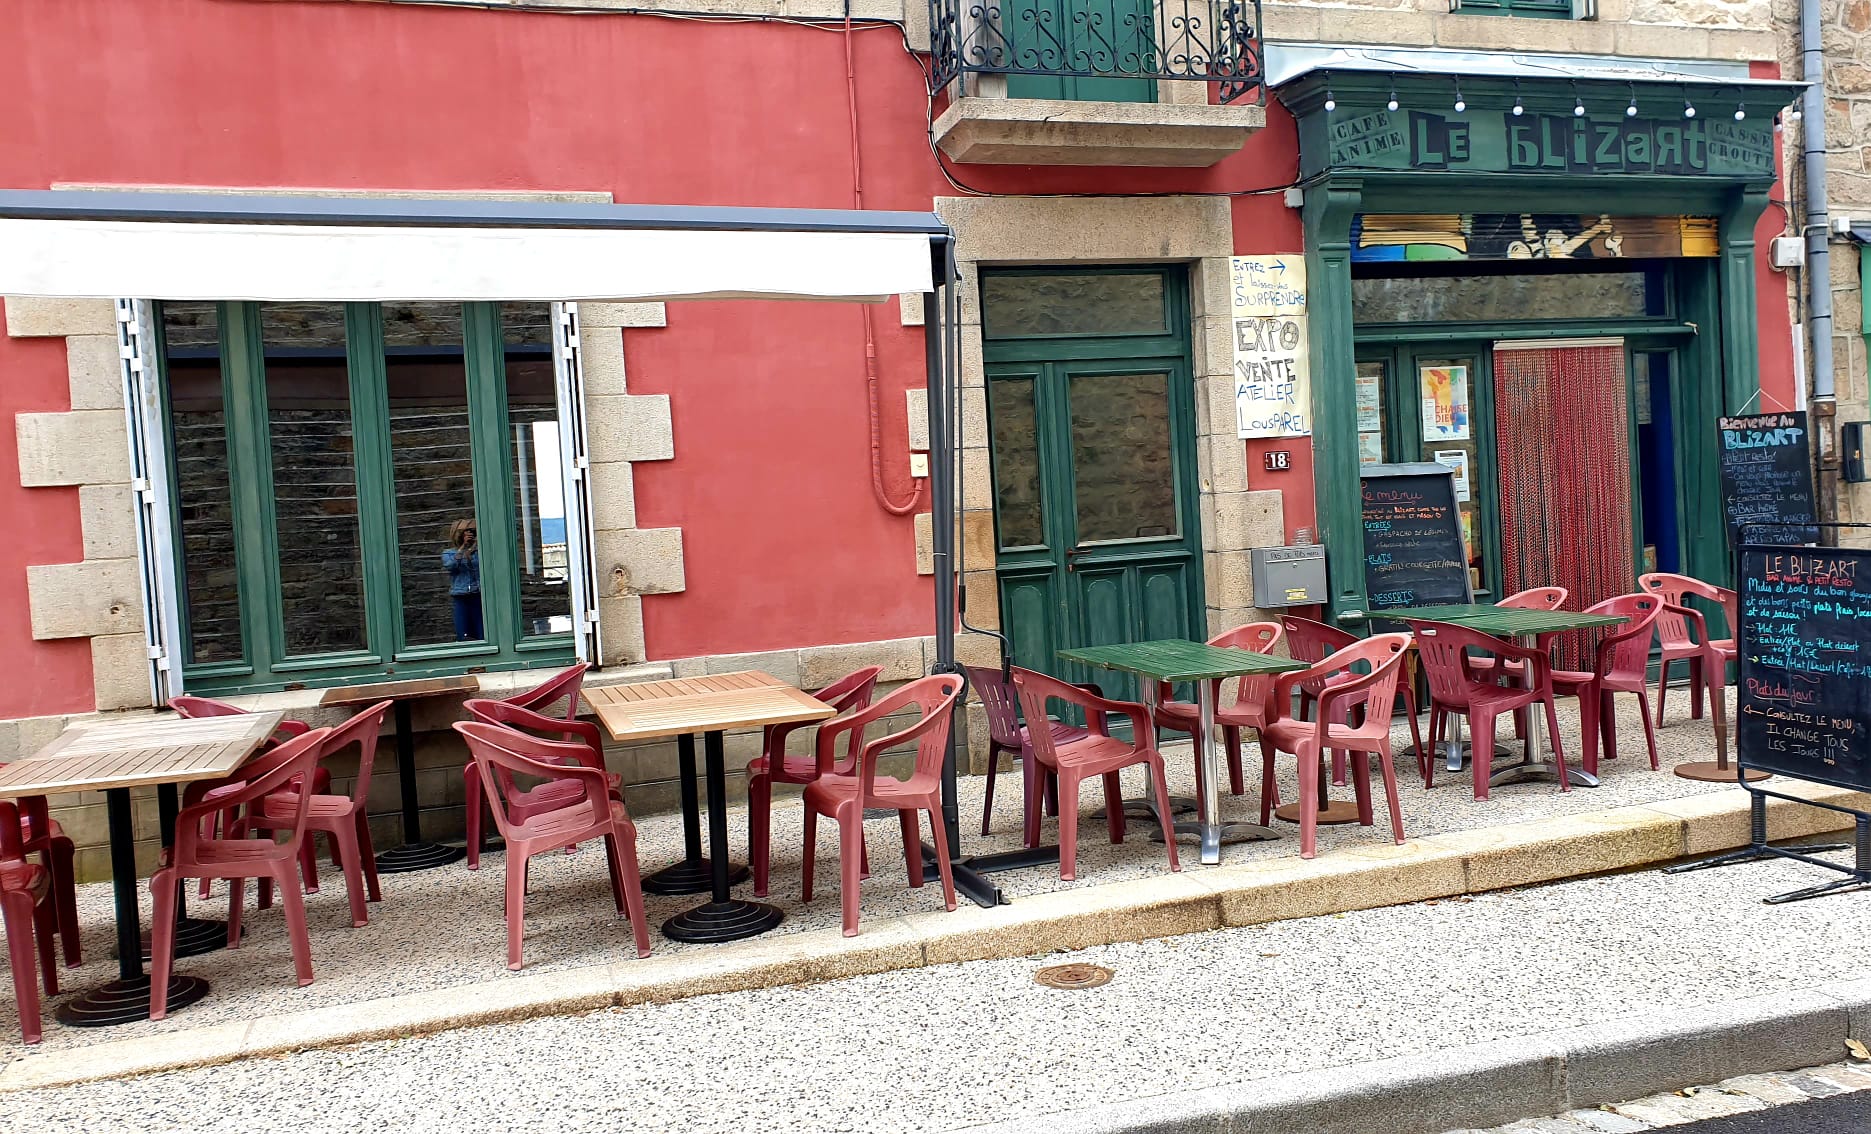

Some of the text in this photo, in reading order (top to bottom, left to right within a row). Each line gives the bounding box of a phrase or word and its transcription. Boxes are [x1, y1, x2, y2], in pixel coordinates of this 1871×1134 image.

[1715, 123, 1770, 148] CASSE
[1233, 272, 1244, 285] et
[1235, 319, 1299, 352] EXPO
[1235, 358, 1296, 383] VENTE
[1435, 404, 1468, 414] CHAISE
[1269, 453, 1287, 468] 18
[1377, 490, 1423, 500] menu
[1765, 555, 1783, 574] LE
[1775, 582, 1785, 593] et
[1816, 715, 1828, 726] LE
[1766, 722, 1781, 735] IL
[1783, 727, 1820, 743] CHANGE
[1768, 738, 1787, 752] LES
